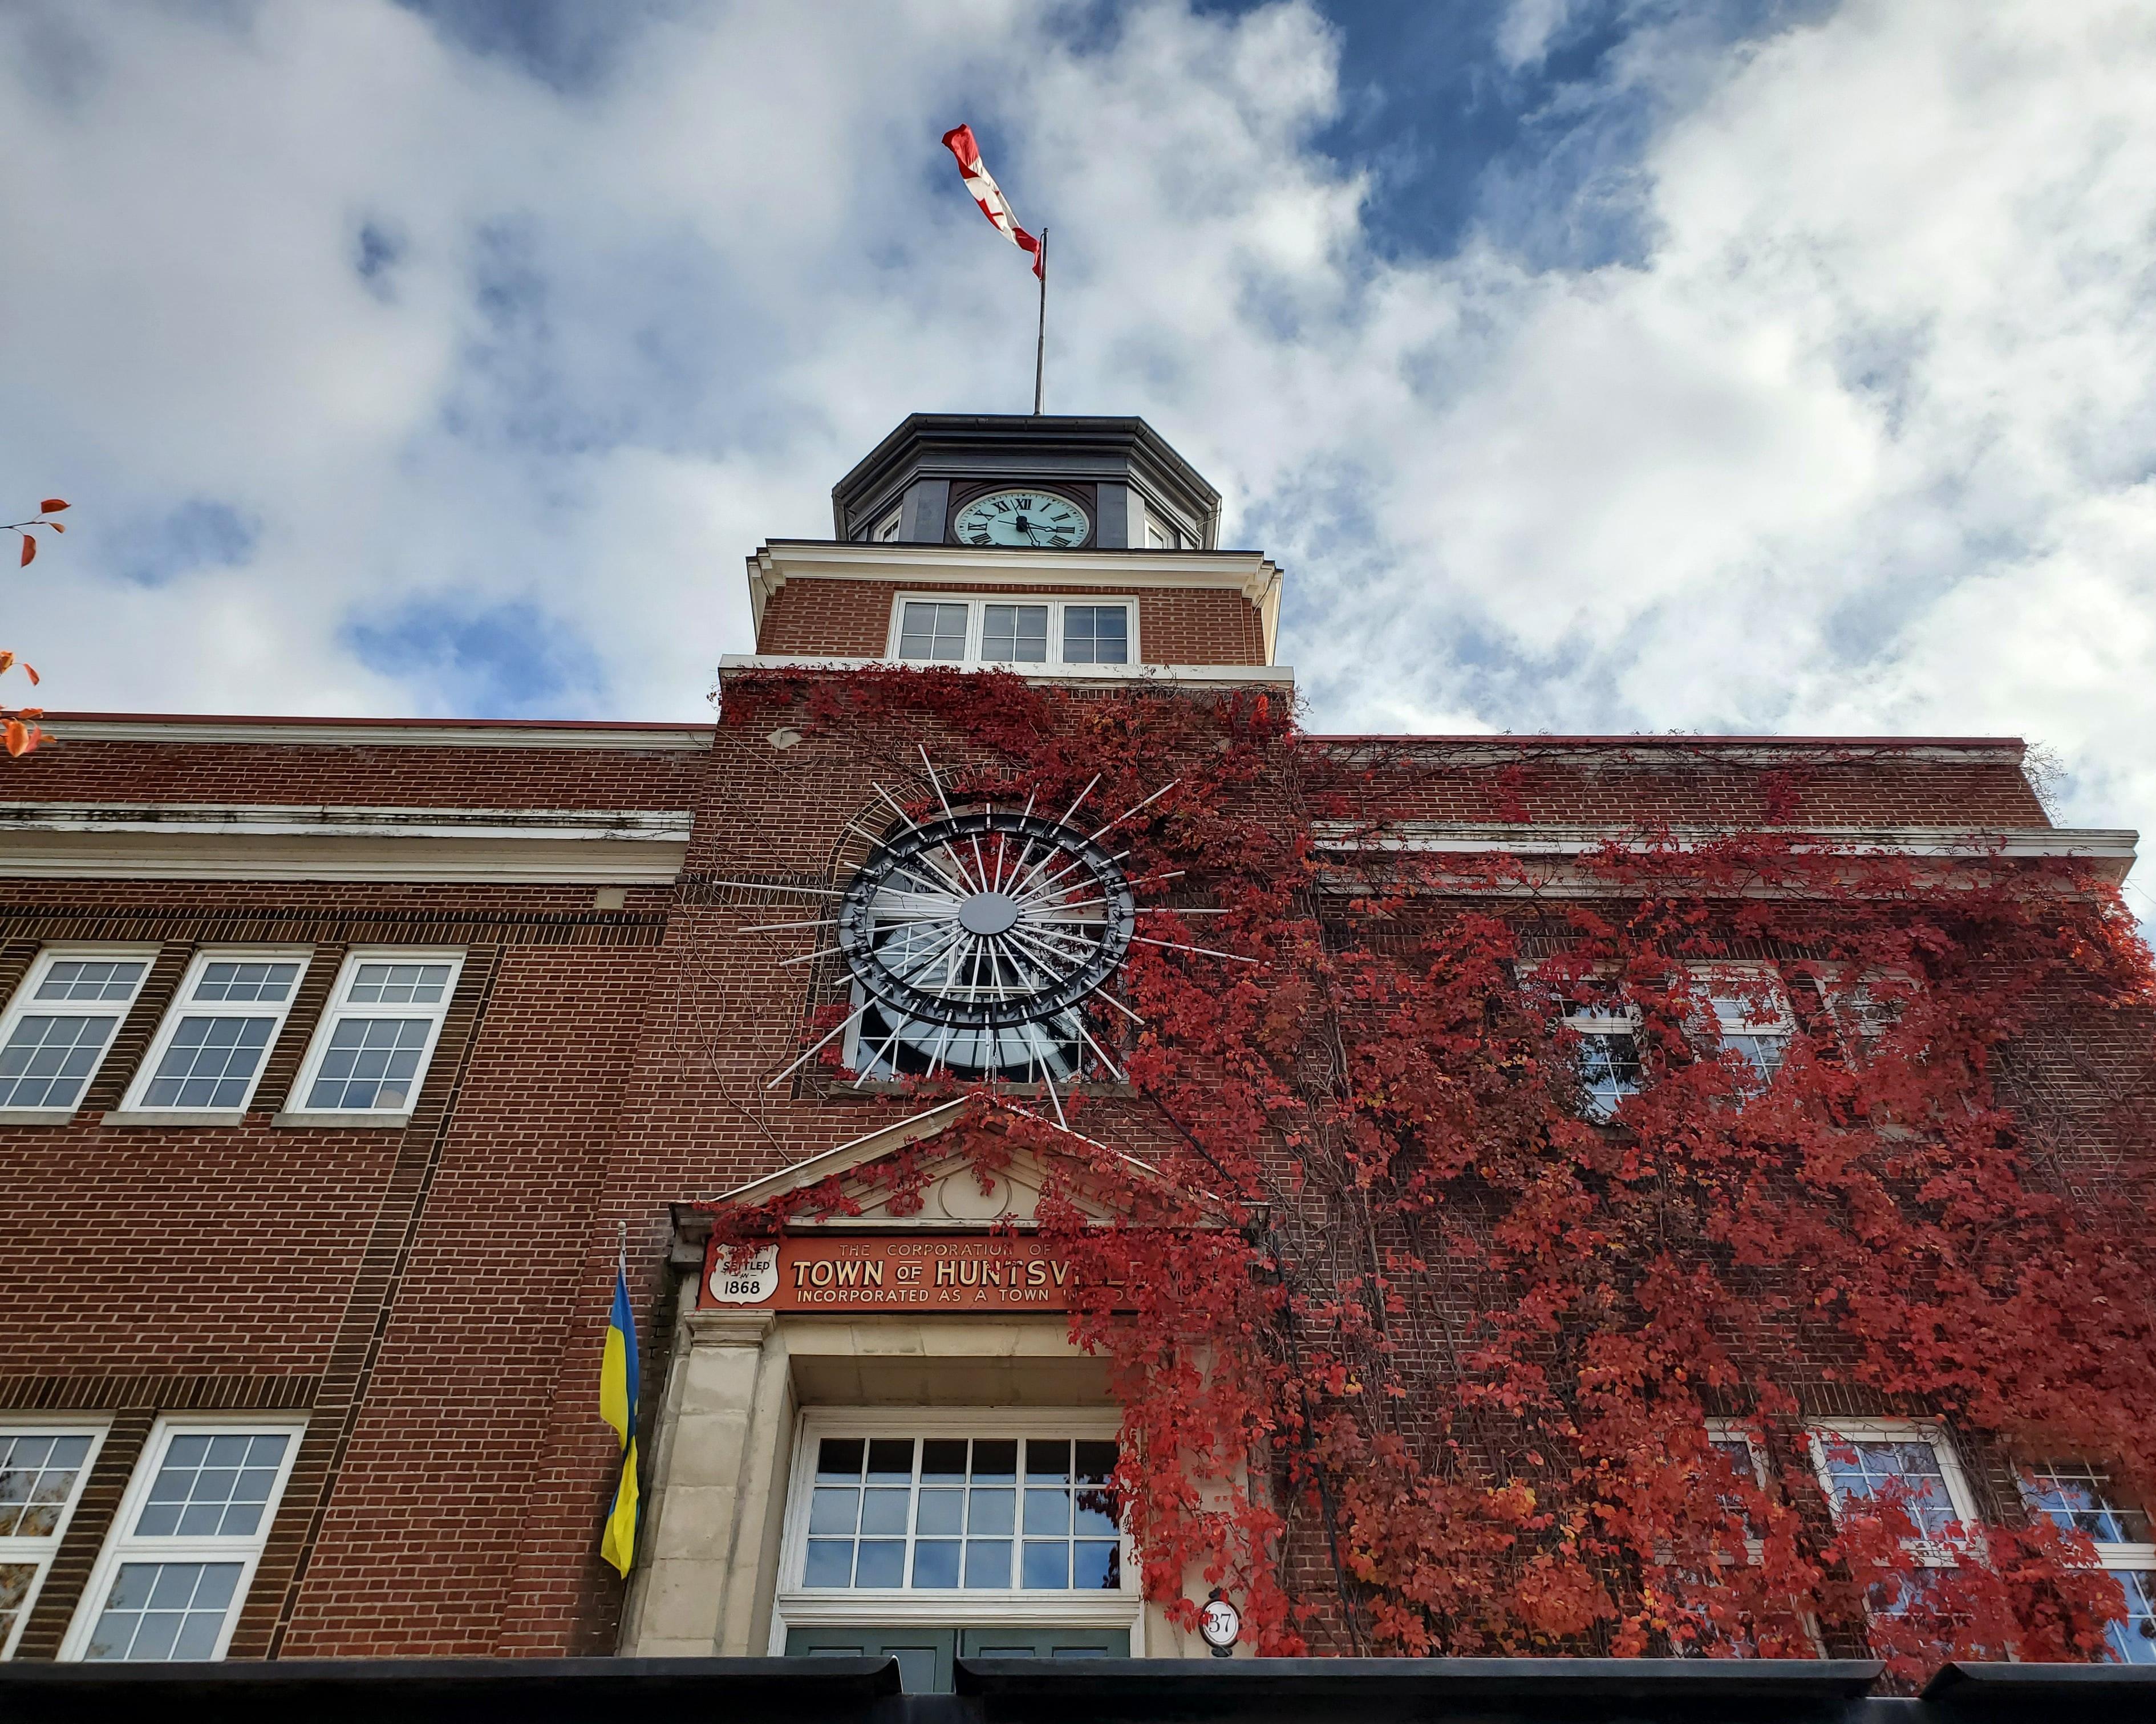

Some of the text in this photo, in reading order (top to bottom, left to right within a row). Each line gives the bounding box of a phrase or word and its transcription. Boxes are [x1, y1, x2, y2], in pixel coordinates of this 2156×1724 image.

[990, 500, 1012, 514] XI
[1014, 498, 1033, 510] XII
[1039, 502, 1052, 512] I
[973, 509, 996, 521] X
[1050, 512, 1071, 522] II
[1056, 525, 1075, 534] III
[839, 1244, 871, 1256] THE
[1028, 1243, 1053, 1256] OF
[792, 1260, 884, 1287] TOWN
[896, 1265, 923, 1280] OF
[724, 1281, 760, 1295] 1868
[797, 1289, 929, 1303] INCORPORATED
[938, 1289, 961, 1302] AS
[974, 1289, 987, 1302] A
[999, 1289, 1048, 1301] TOWN
[1209, 1613, 1231, 1633] 37
